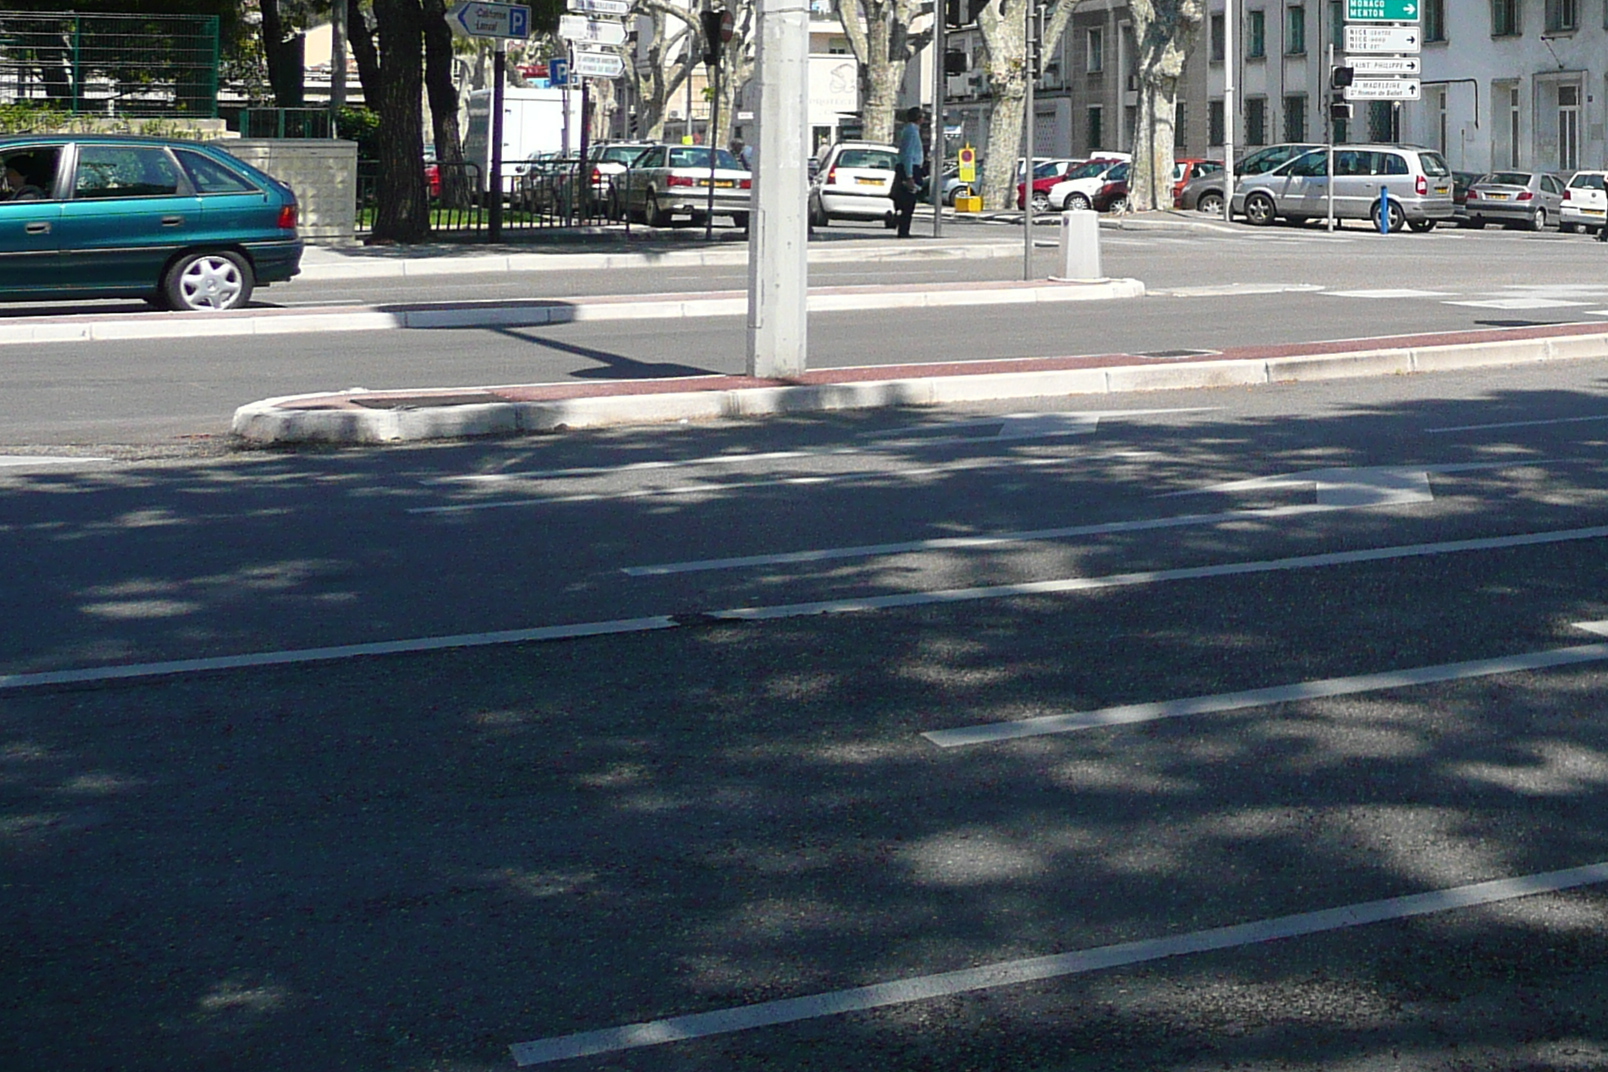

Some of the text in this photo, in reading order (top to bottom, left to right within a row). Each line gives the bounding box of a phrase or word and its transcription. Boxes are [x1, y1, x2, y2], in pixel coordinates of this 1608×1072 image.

[1349, 9, 1385, 18] MENTON
[1350, 61, 1404, 70] SAINT PHILIPPE
